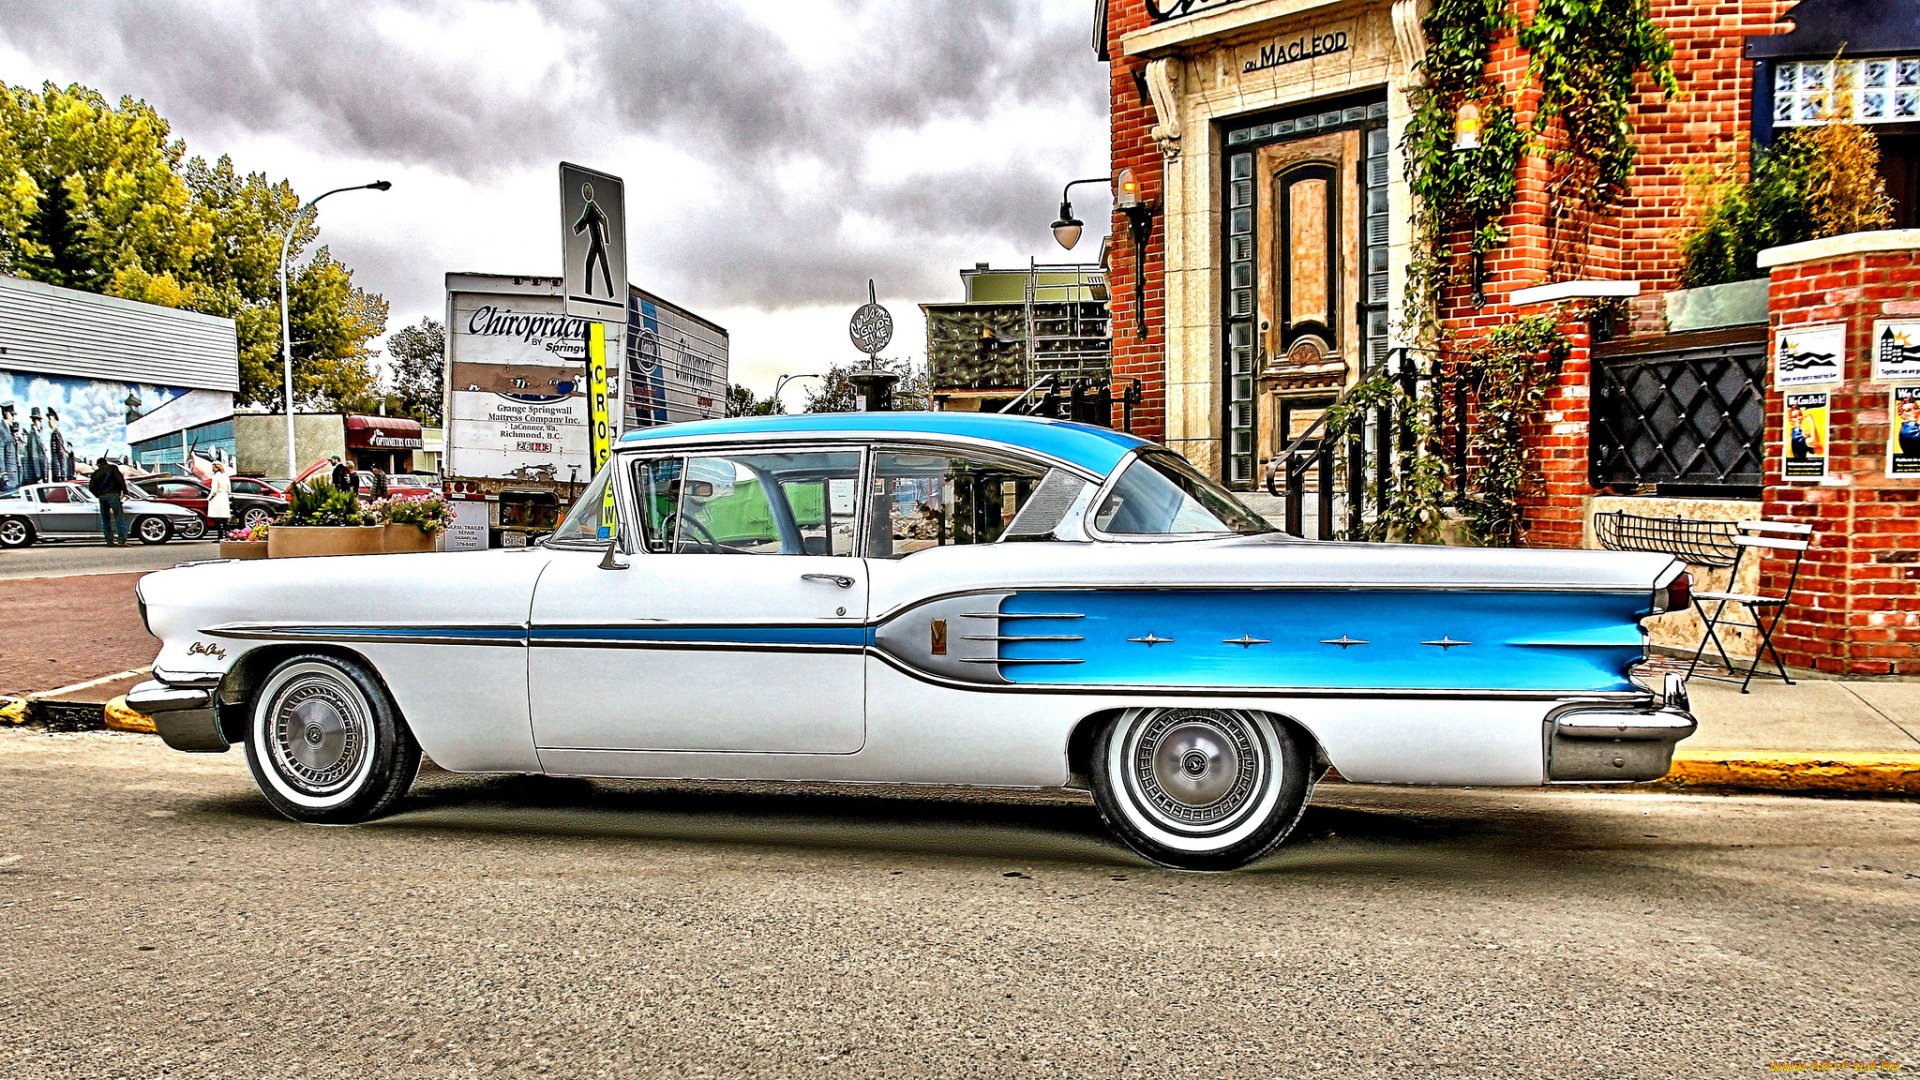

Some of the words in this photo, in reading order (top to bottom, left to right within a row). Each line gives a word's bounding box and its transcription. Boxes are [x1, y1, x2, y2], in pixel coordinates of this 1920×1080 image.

[531, 338, 542, 346] BY
[497, 404, 526, 414] Grange
[528, 405, 572, 415] Springwall
[488, 413, 523, 421] Mattress
[524, 414, 563, 424] Company
[564, 416, 580, 424] Inc.
